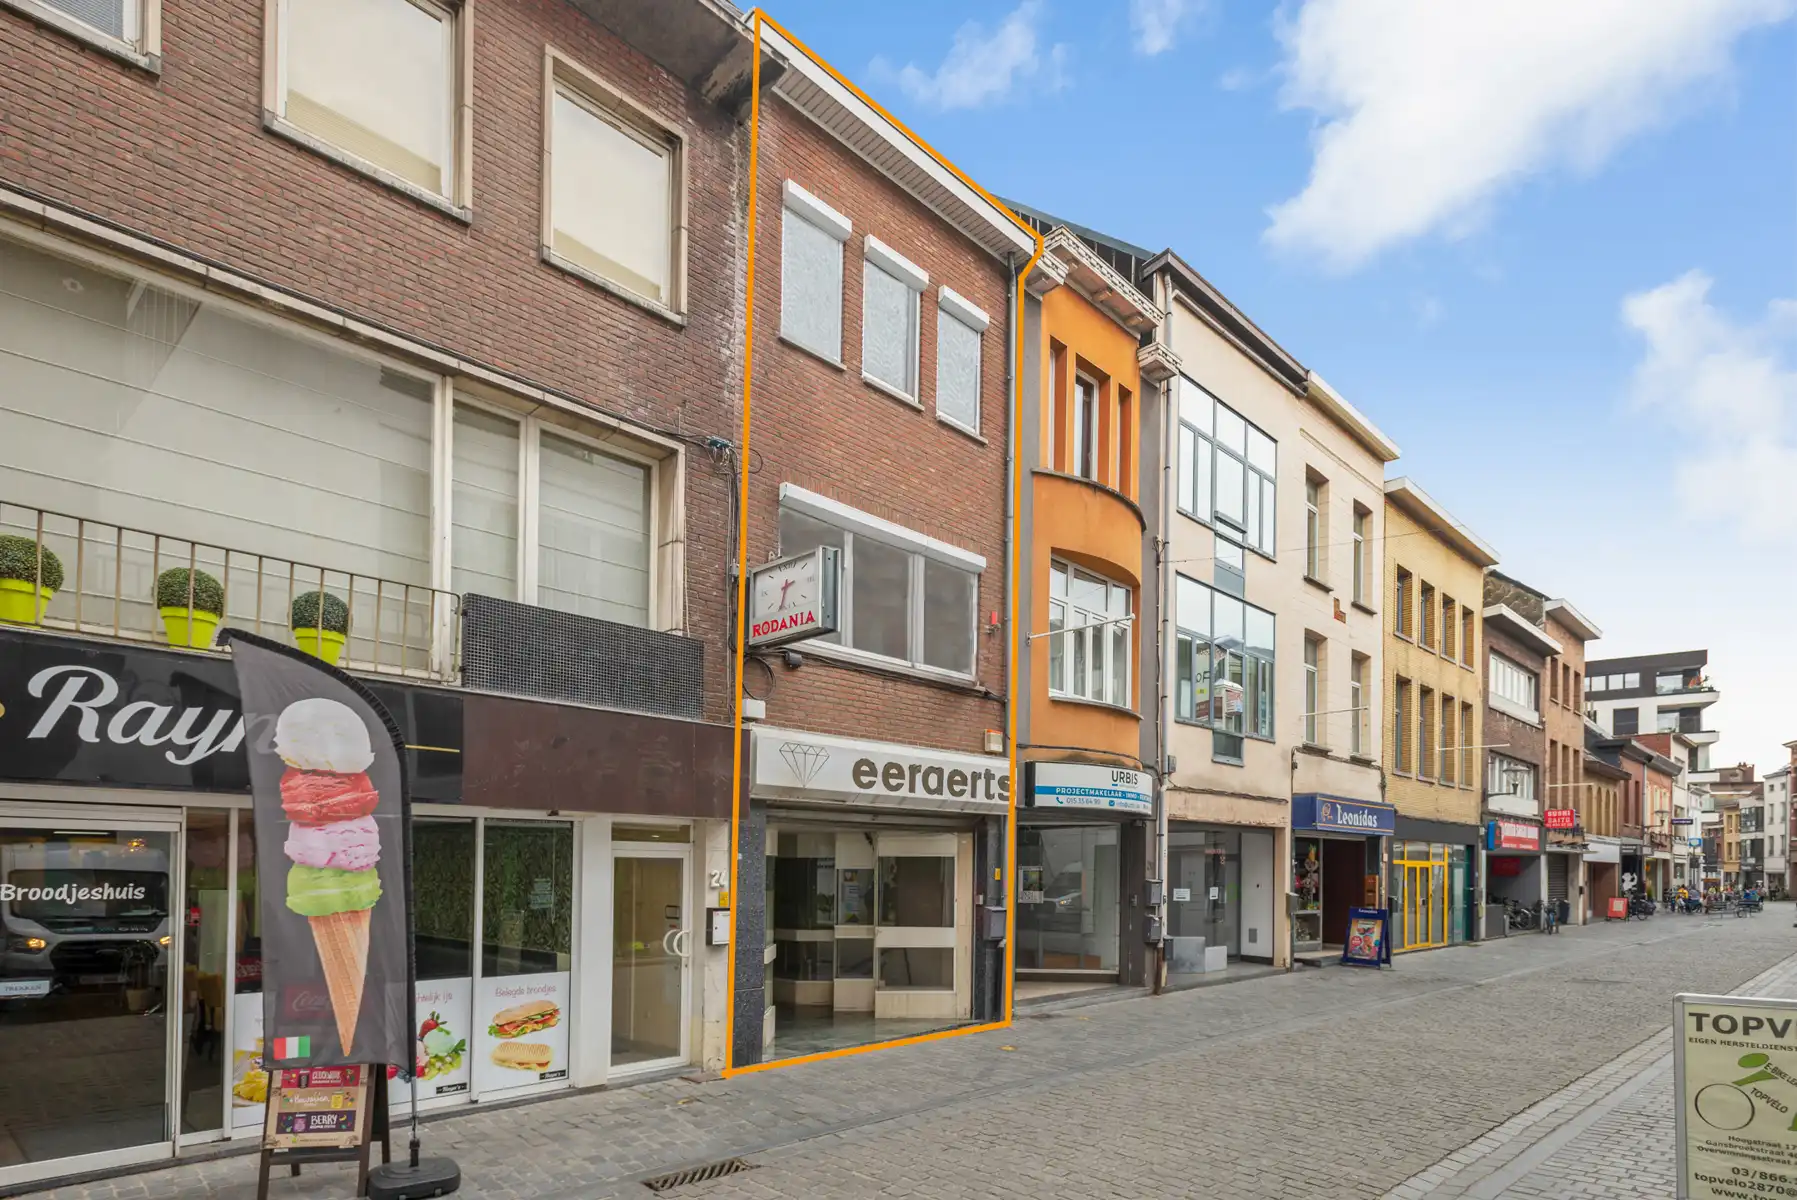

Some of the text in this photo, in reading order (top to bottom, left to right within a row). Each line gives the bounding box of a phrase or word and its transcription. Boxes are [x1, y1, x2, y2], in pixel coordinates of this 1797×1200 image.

[752, 610, 816, 638] RODANIA
[1112, 770, 1138, 785] URBIS
[1055, 787, 1122, 798] PROJECTMAKELAAR
[1337, 803, 1378, 828] Leonidas
[0, 883, 146, 904] Broodjeshuis
[1688, 1012, 1797, 1041] TOPV
[1688, 1037, 1717, 1045] EIGEN
[1763, 1062, 1789, 1080] E-BIKE
[1750, 1087, 1789, 1114] TOPVÉLO
[311, 1114, 338, 1126] BERRY
[1705, 1139, 1786, 1157] Gansbroekstraat
[1728, 1135, 1782, 1149] Hoogstraat
